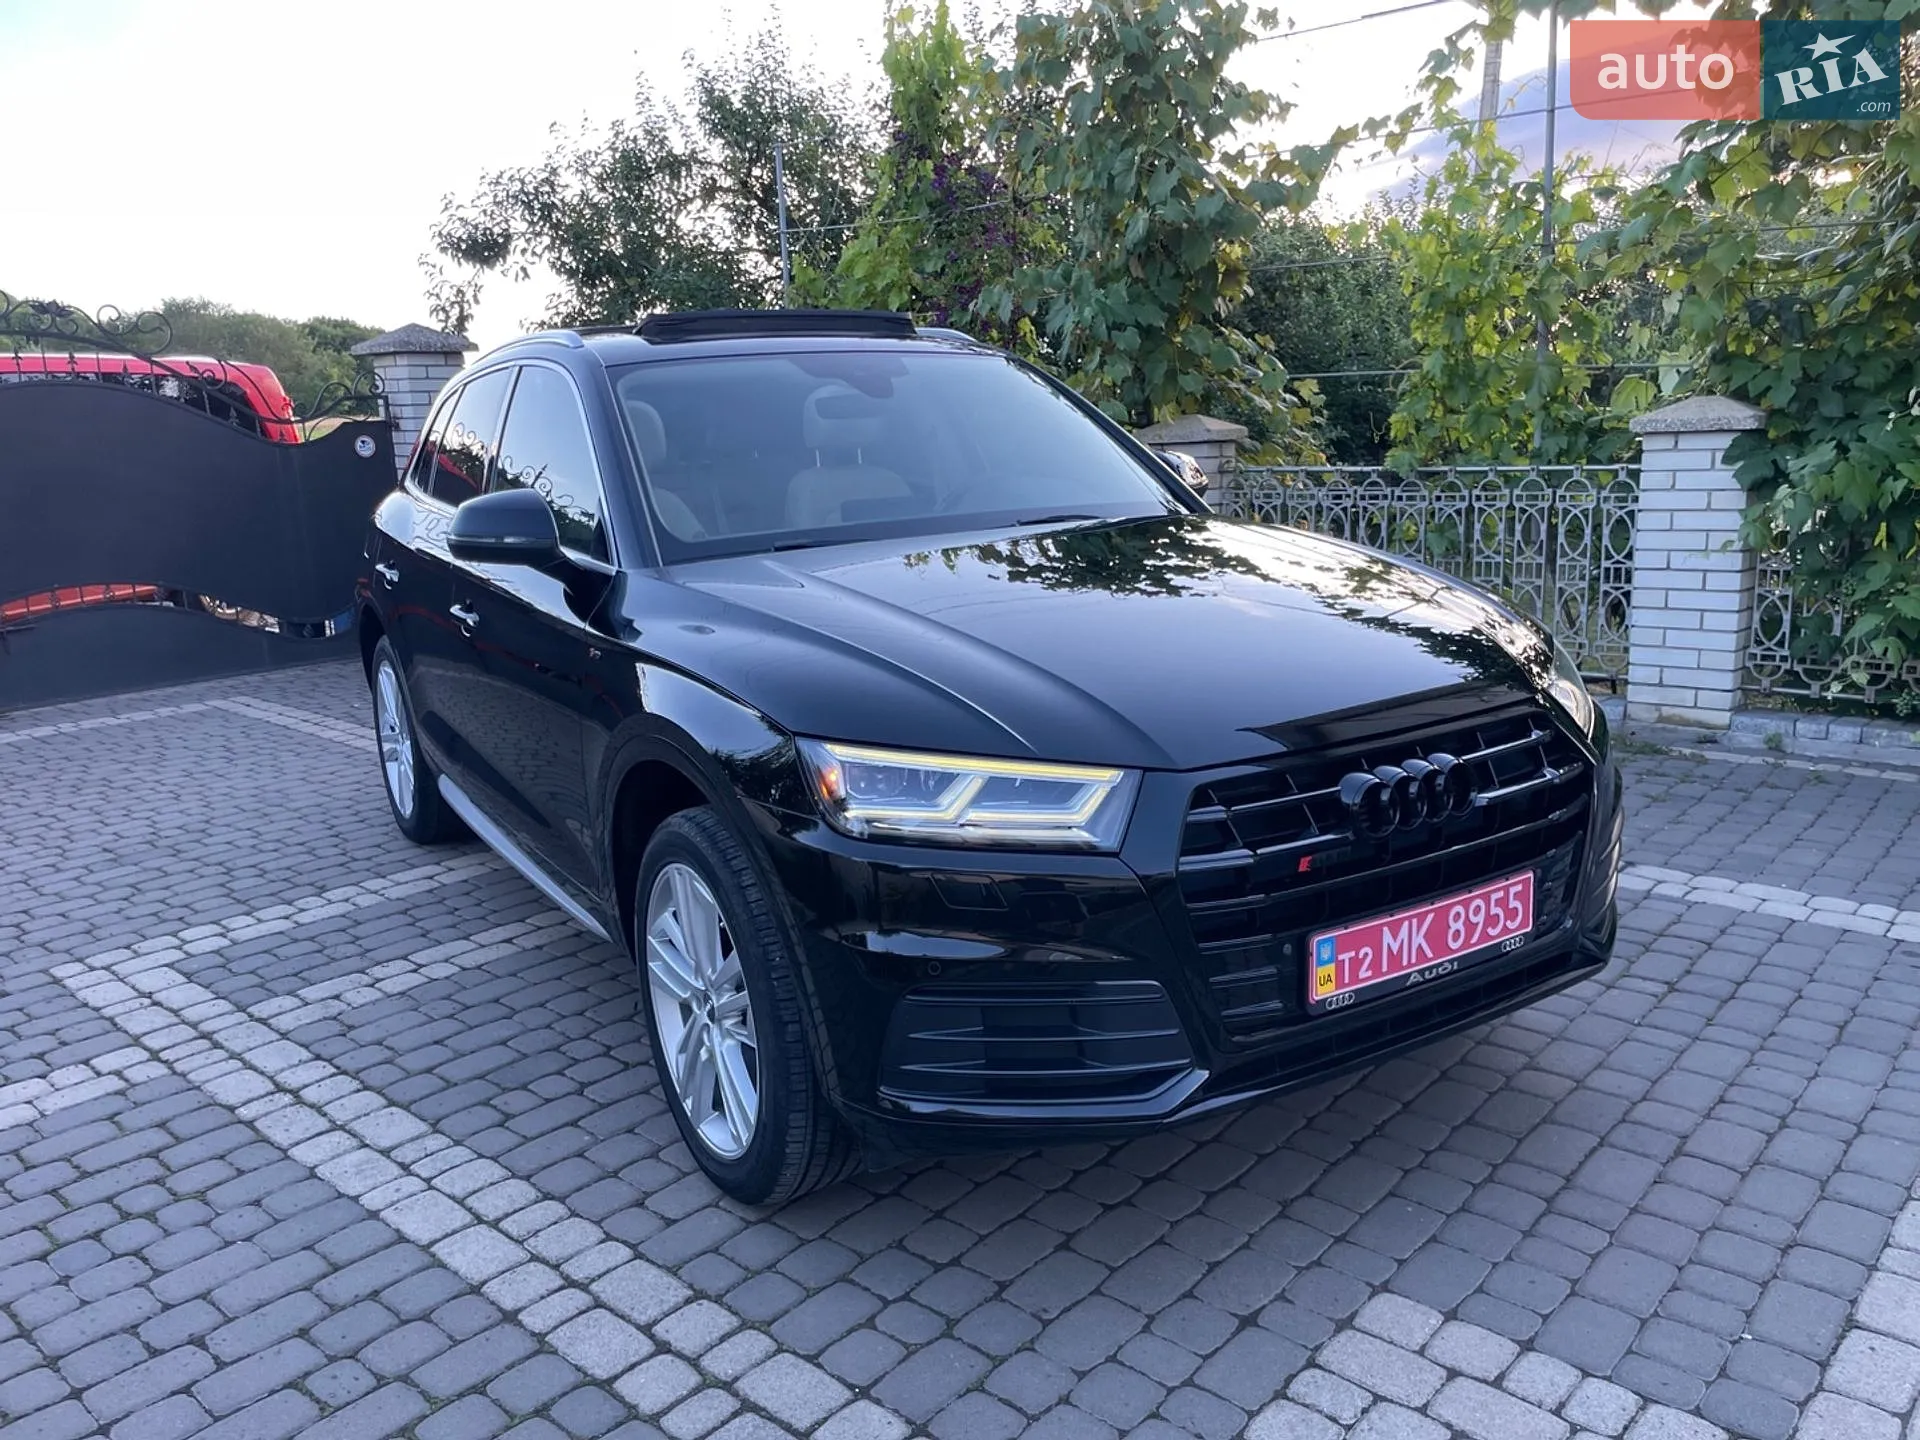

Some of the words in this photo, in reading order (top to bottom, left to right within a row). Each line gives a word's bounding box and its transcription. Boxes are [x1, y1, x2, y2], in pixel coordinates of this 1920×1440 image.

[1338, 946, 1373, 984] T2
[1382, 912, 1436, 973] MK
[1447, 884, 1524, 950] 8955
[1318, 971, 1334, 987] UA
[1406, 961, 1459, 986] Audi
